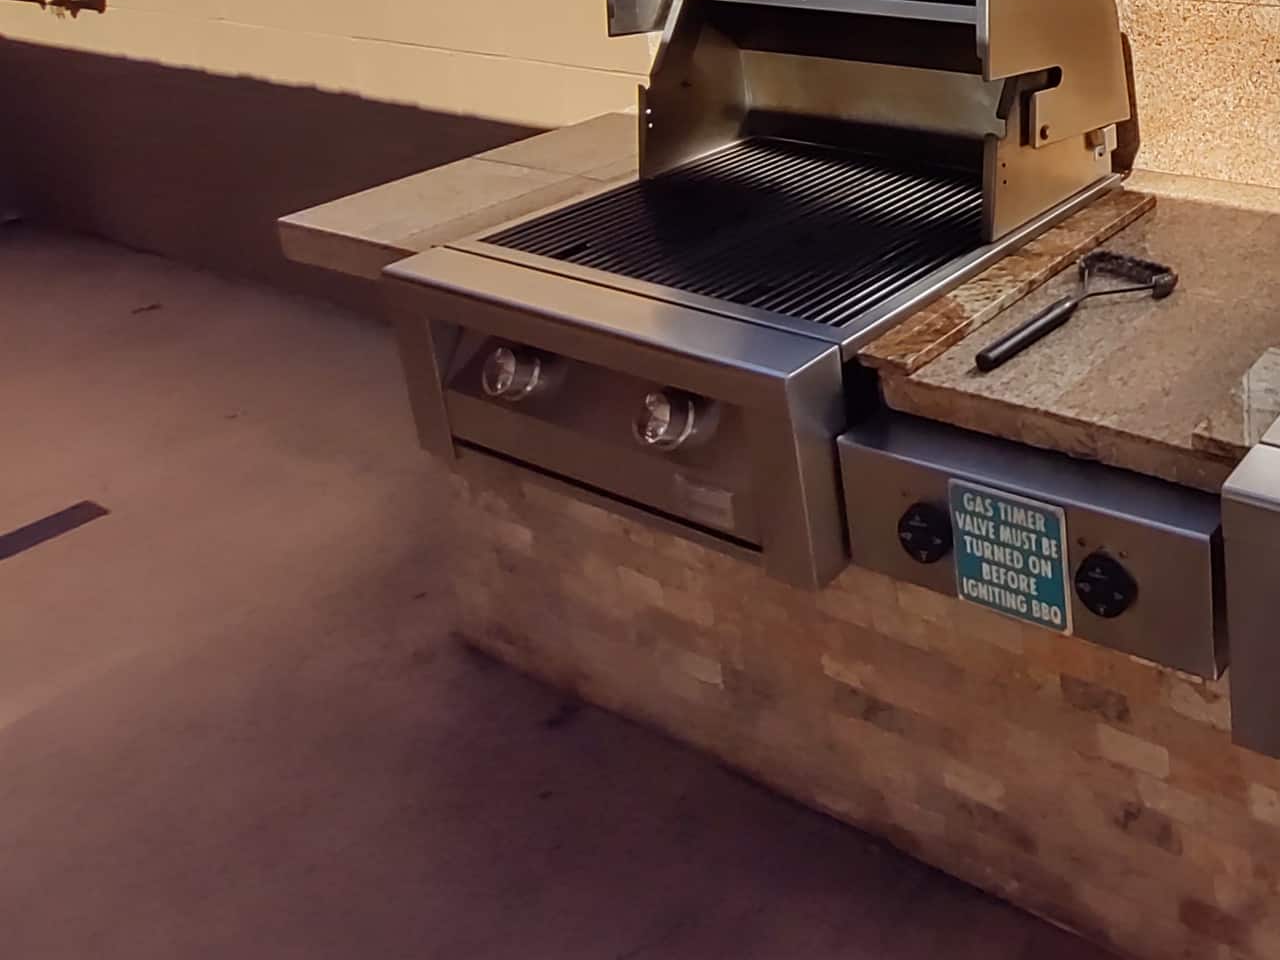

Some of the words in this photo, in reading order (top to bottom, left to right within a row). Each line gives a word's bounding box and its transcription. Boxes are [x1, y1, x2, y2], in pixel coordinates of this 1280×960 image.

[963, 493, 993, 517] GAS
[998, 502, 1046, 532] TIMER
[955, 512, 995, 540] VALVE
[1000, 524, 1036, 551] MUST
[1042, 538, 1057, 558] BE
[964, 535, 1022, 569] TURNED
[1029, 557, 1052, 578] ON
[982, 563, 1037, 595] BEFORE
[963, 577, 1027, 613] IGNITING
[1032, 602, 1062, 625] BBQ
